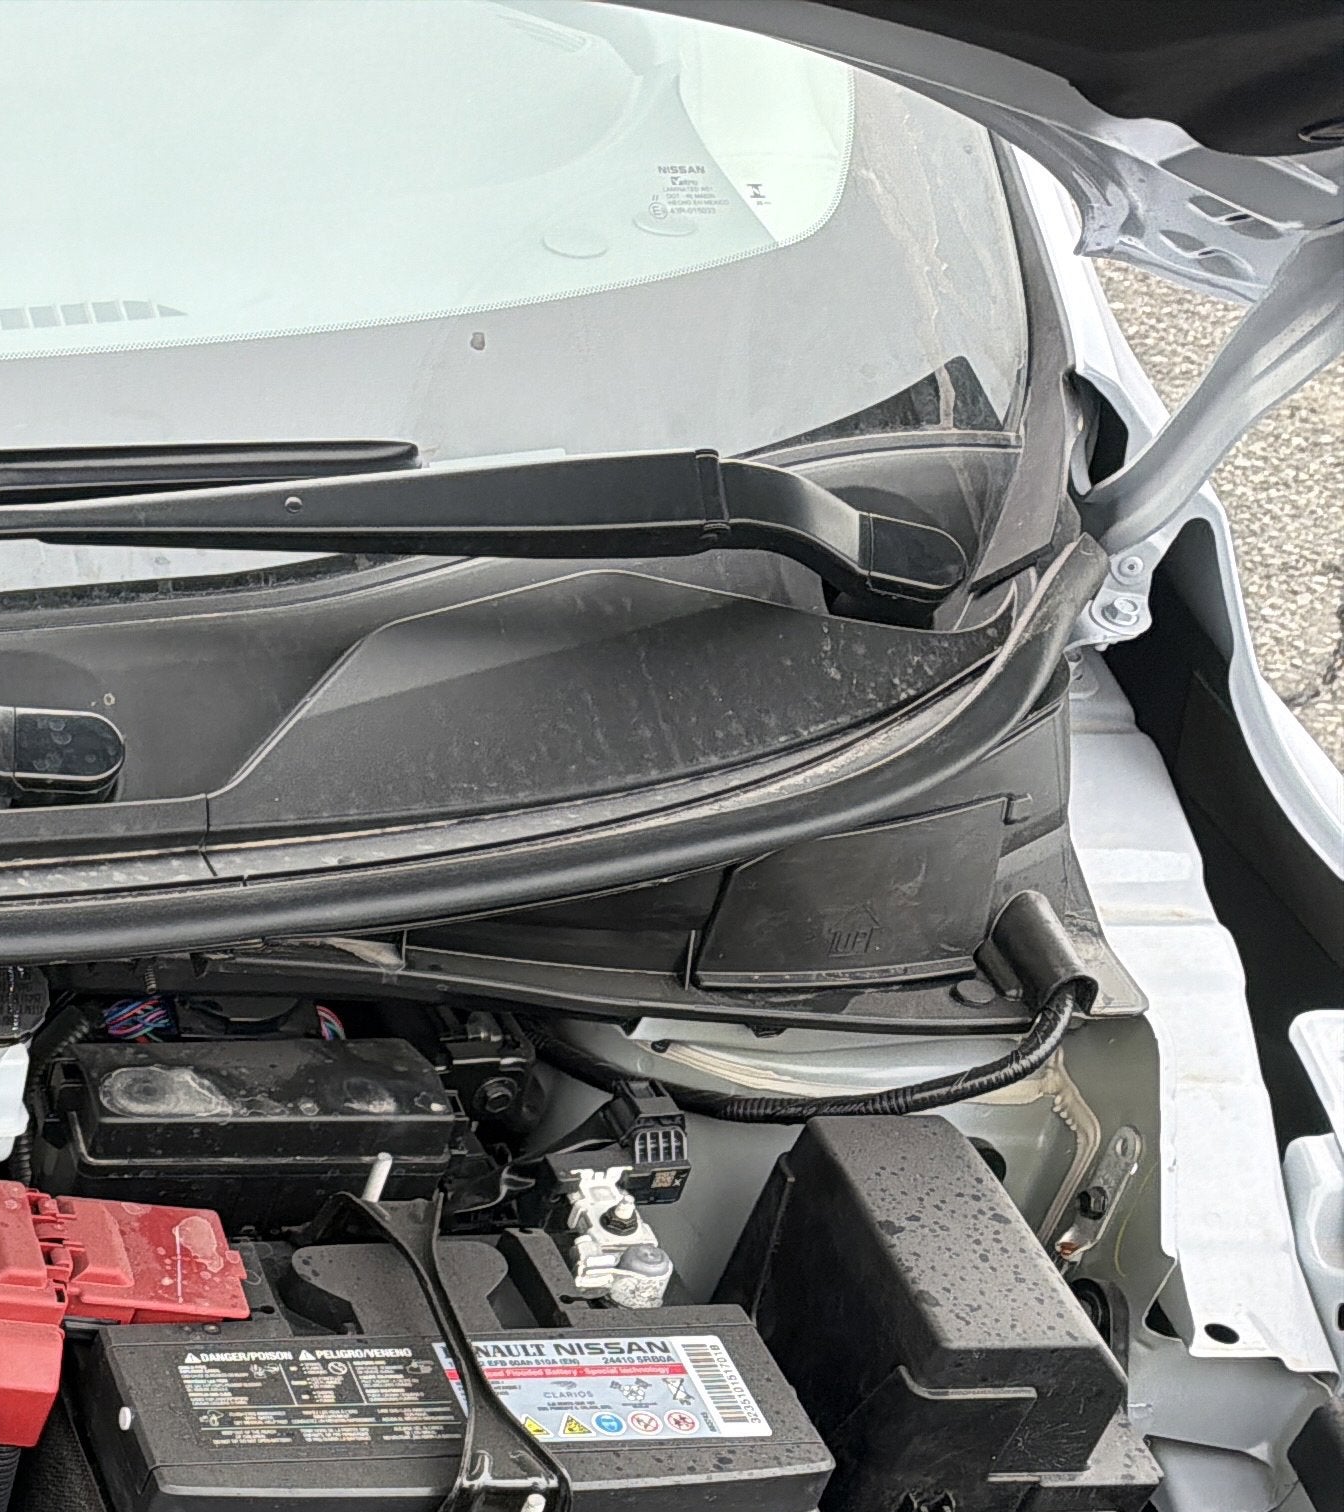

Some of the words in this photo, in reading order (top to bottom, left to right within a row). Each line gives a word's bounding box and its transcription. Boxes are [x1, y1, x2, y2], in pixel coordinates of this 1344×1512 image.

[657, 165, 706, 174] NISSAN
[315, 1348, 412, 1359] PELIGRO/VENENO
[553, 1341, 671, 1356] NISSAN
[200, 1351, 293, 1362] DANGER/POISON
[543, 1391, 594, 1399] CLARIOS
